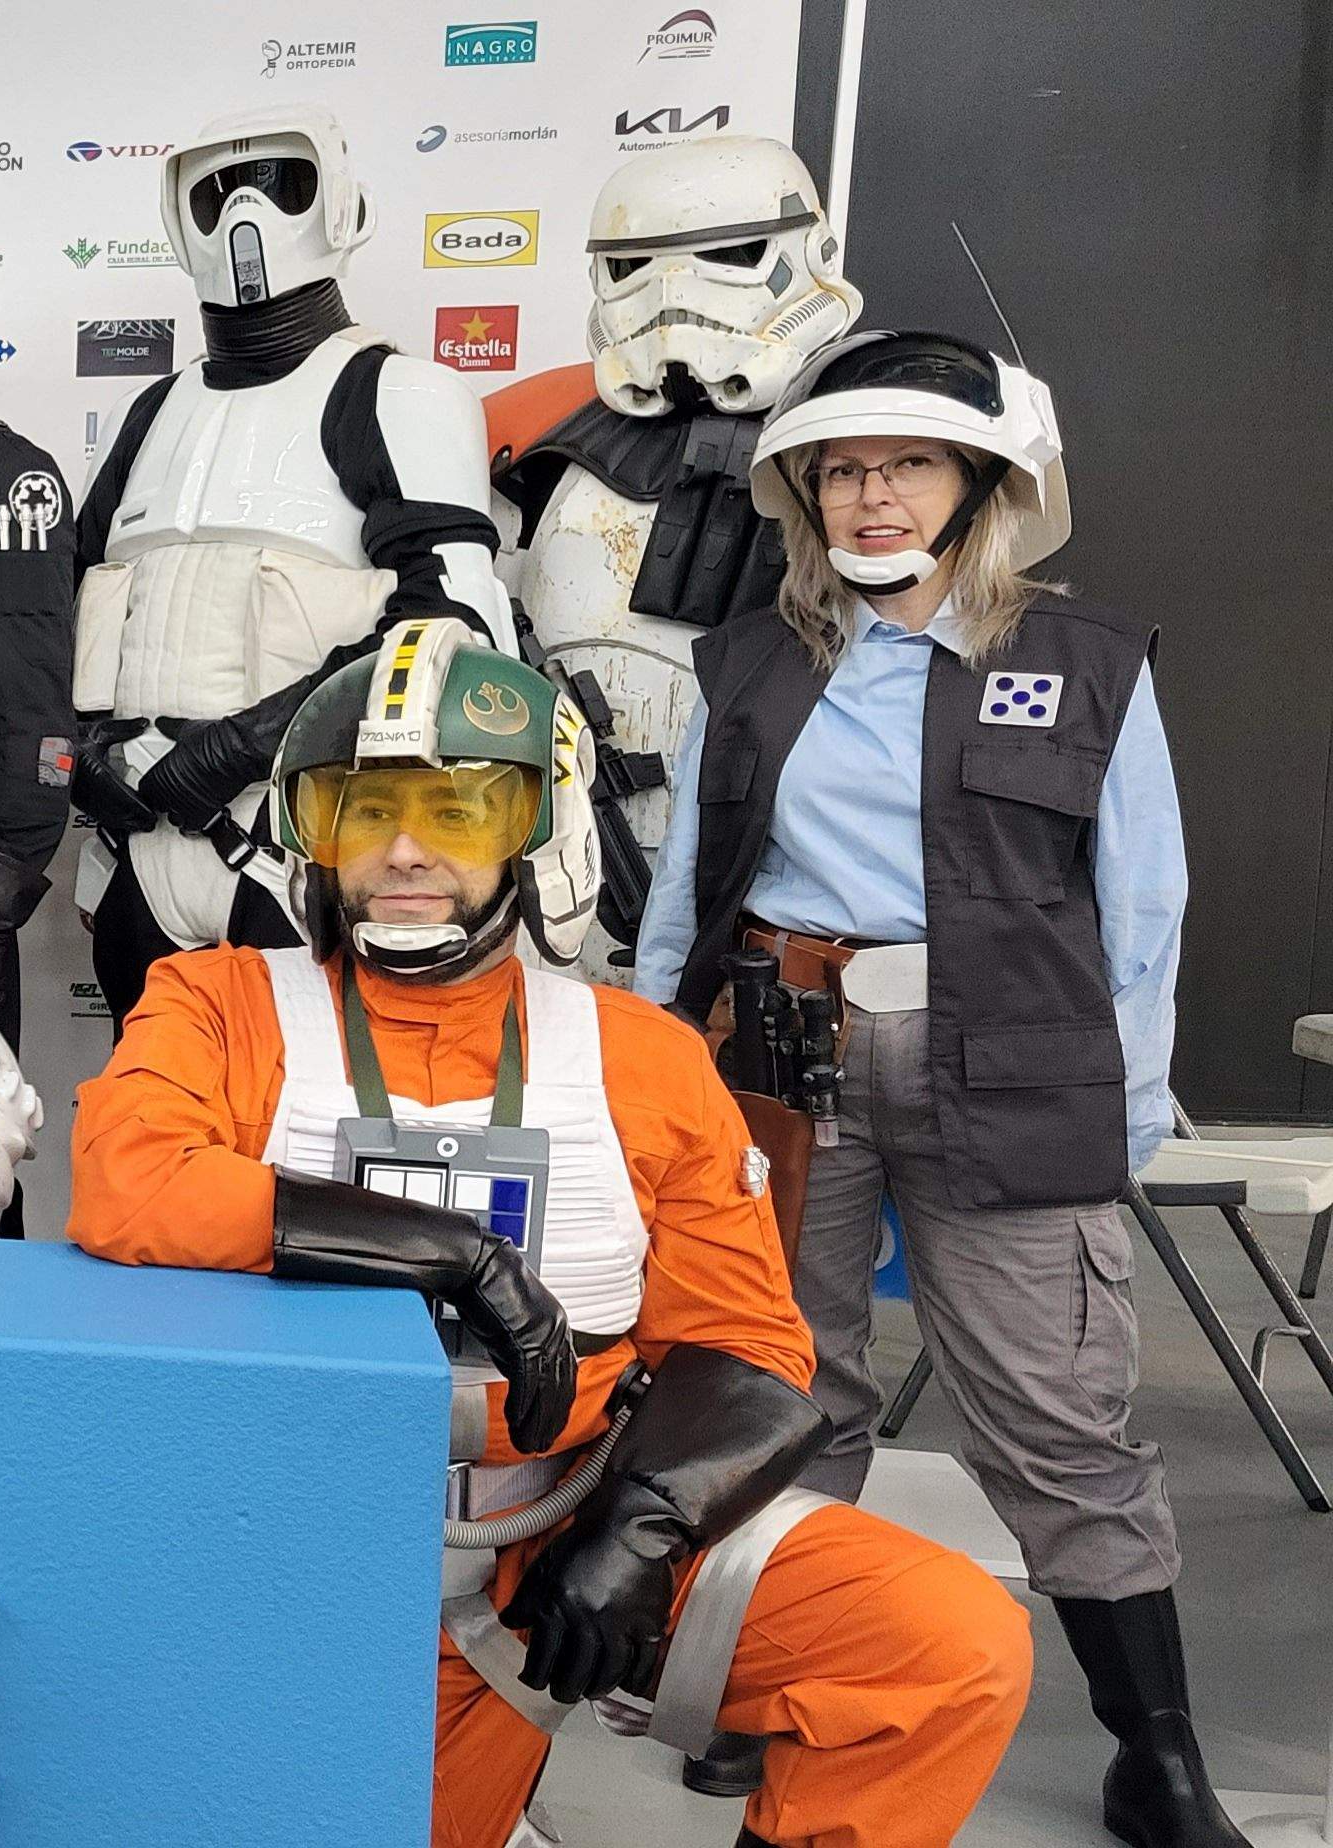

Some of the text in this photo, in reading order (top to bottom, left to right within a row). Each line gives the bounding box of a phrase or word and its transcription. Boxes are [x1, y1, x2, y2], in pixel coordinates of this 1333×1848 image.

[647, 31, 714, 45] PROIMUR
[286, 41, 356, 57] ALTEMIR
[447, 39, 534, 57] INAGRO
[286, 58, 356, 71] ORTOPEDIA
[107, 240, 169, 255] Fundac
[441, 231, 523, 249] Bada
[439, 339, 511, 358] Estrella
[459, 356, 491, 368] Damm
